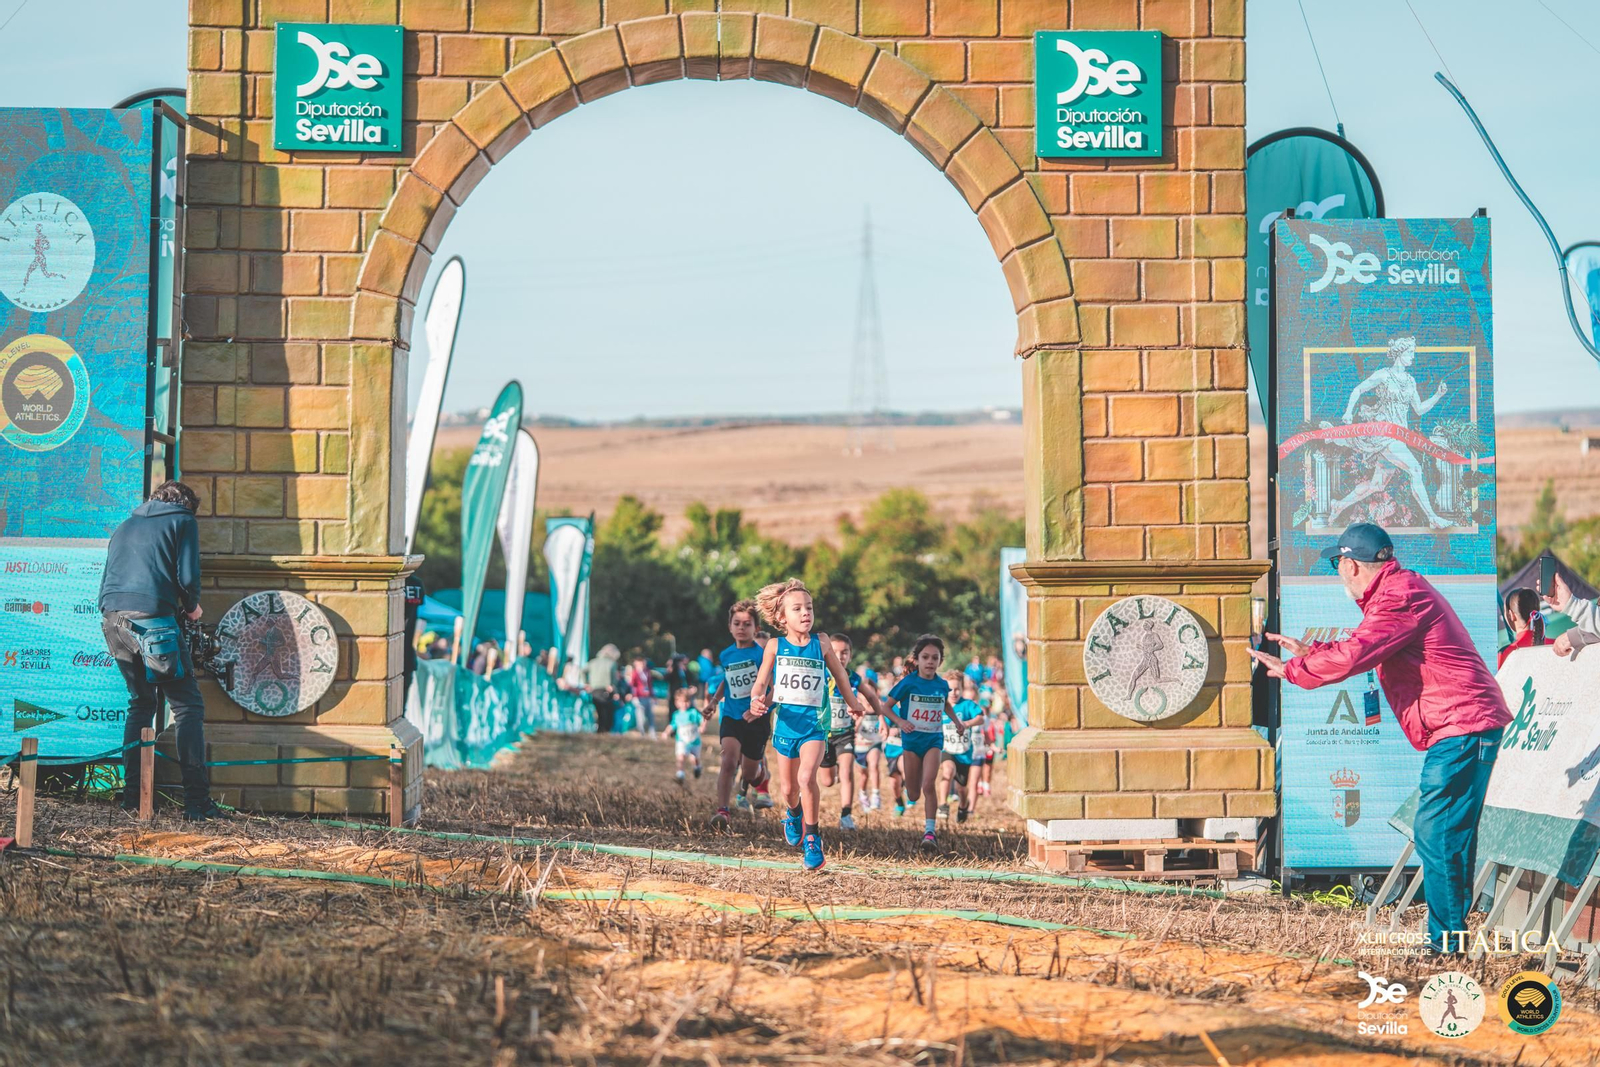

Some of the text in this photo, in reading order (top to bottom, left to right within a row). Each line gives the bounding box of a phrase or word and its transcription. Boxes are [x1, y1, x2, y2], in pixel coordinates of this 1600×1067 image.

[296, 101, 382, 118] Diputación
[1057, 108, 1142, 126] Diputación
[296, 118, 382, 142] Sevilla
[1057, 125, 1142, 148] Sevilla
[1387, 248, 1460, 264] Diputación
[1387, 265, 1460, 284] Sevilla
[22, 404, 53, 412] WORLD
[1092, 599, 1204, 684] ITALICA
[21, 661, 51, 669] SEVILLA
[730, 671, 757, 688] 4665
[780, 673, 821, 691] 4667
[912, 709, 942, 723] 4428
[1306, 727, 1380, 736] Junta de Andalucía
